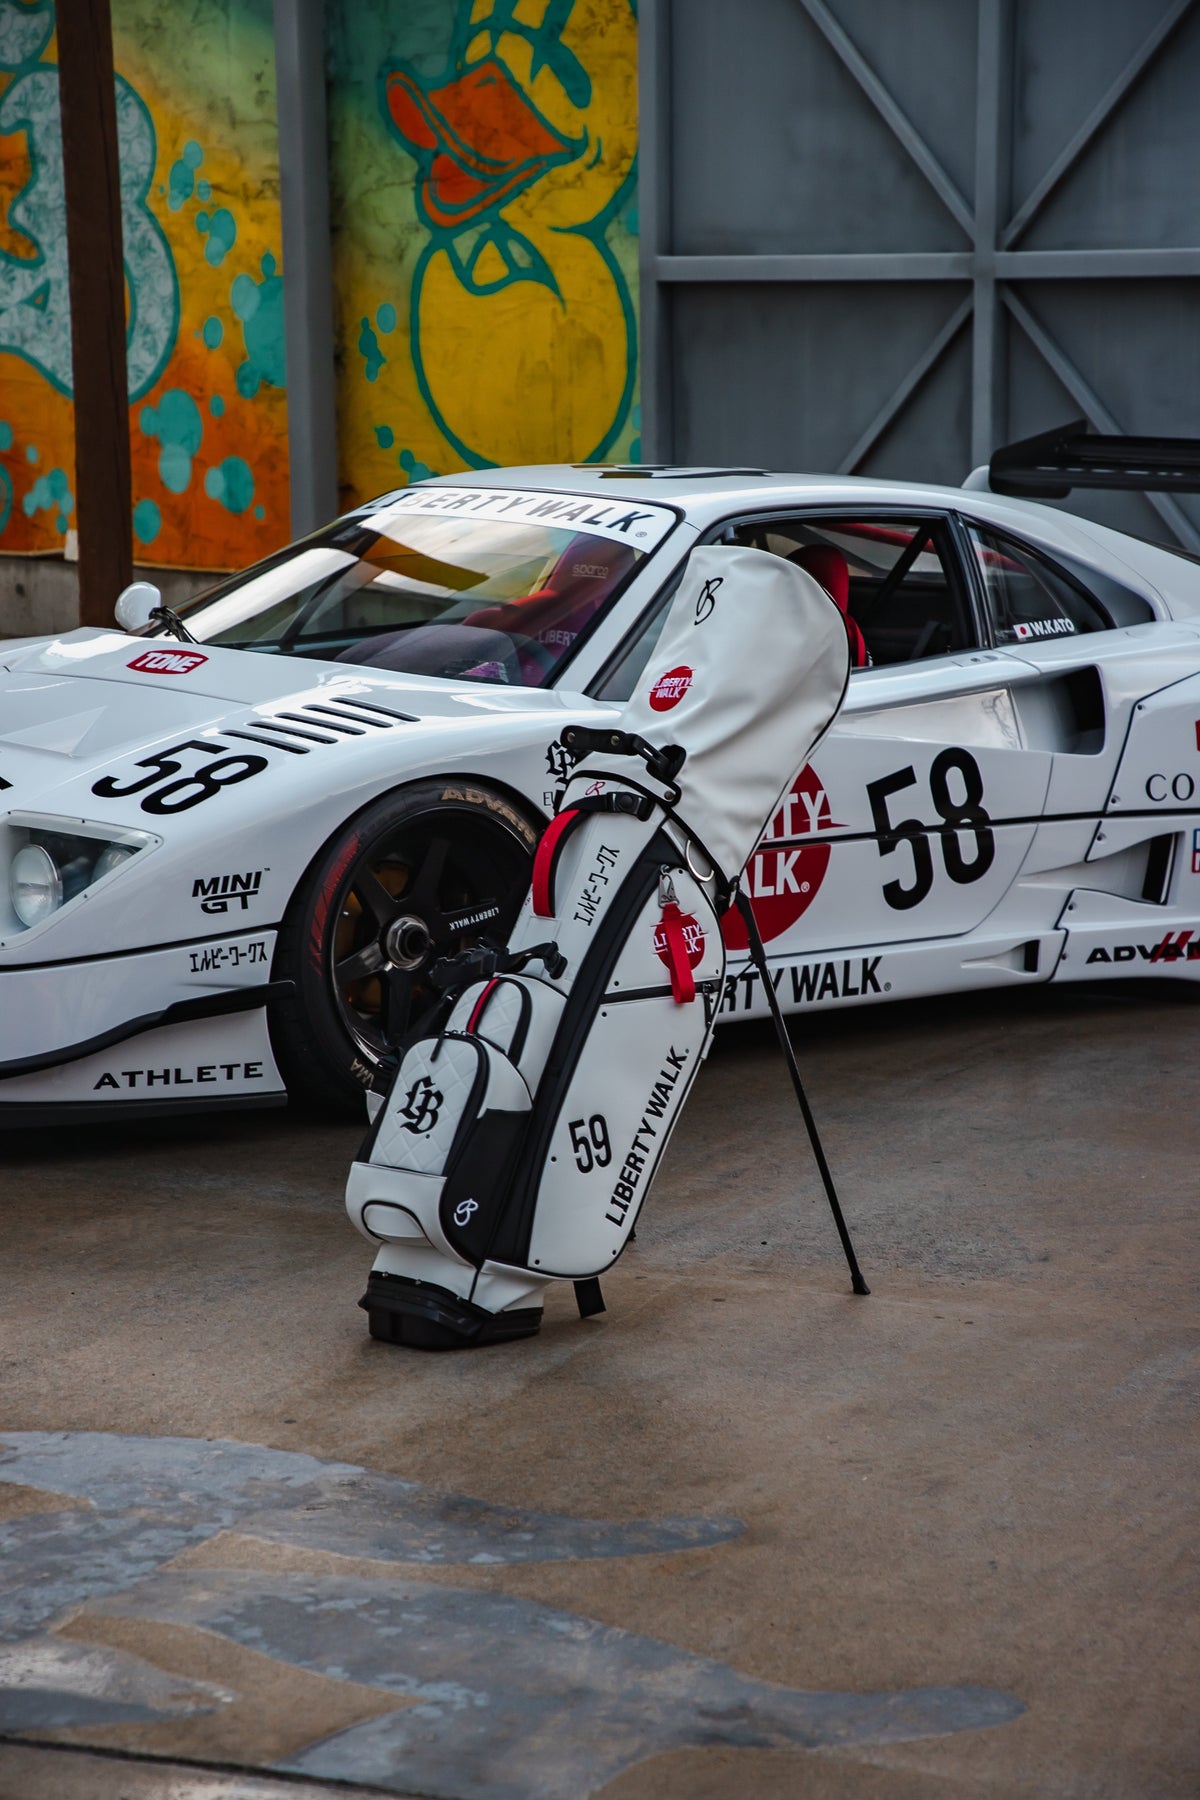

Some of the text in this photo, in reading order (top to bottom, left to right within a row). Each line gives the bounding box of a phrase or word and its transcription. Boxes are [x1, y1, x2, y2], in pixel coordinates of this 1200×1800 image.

[361, 492, 656, 533] LIBERTY WALK
[572, 564, 609, 577] sparco
[539, 630, 578, 647] LIBERT
[1029, 617, 1075, 637] W.KATO
[136, 651, 201, 673] TONE
[655, 676, 693, 688] LIBERTY
[655, 687, 681, 698] WALK
[91, 739, 269, 815] 58
[865, 746, 996, 911] 58
[192, 871, 263, 898] MINI
[201, 890, 259, 914] GT
[448, 907, 500, 931] LIBERTY WALK
[790, 955, 883, 1004] WALK
[94, 1061, 264, 1090] ATHLETE
[568, 1113, 613, 1174] 59
[605, 1116, 657, 1228] LIBERTY
